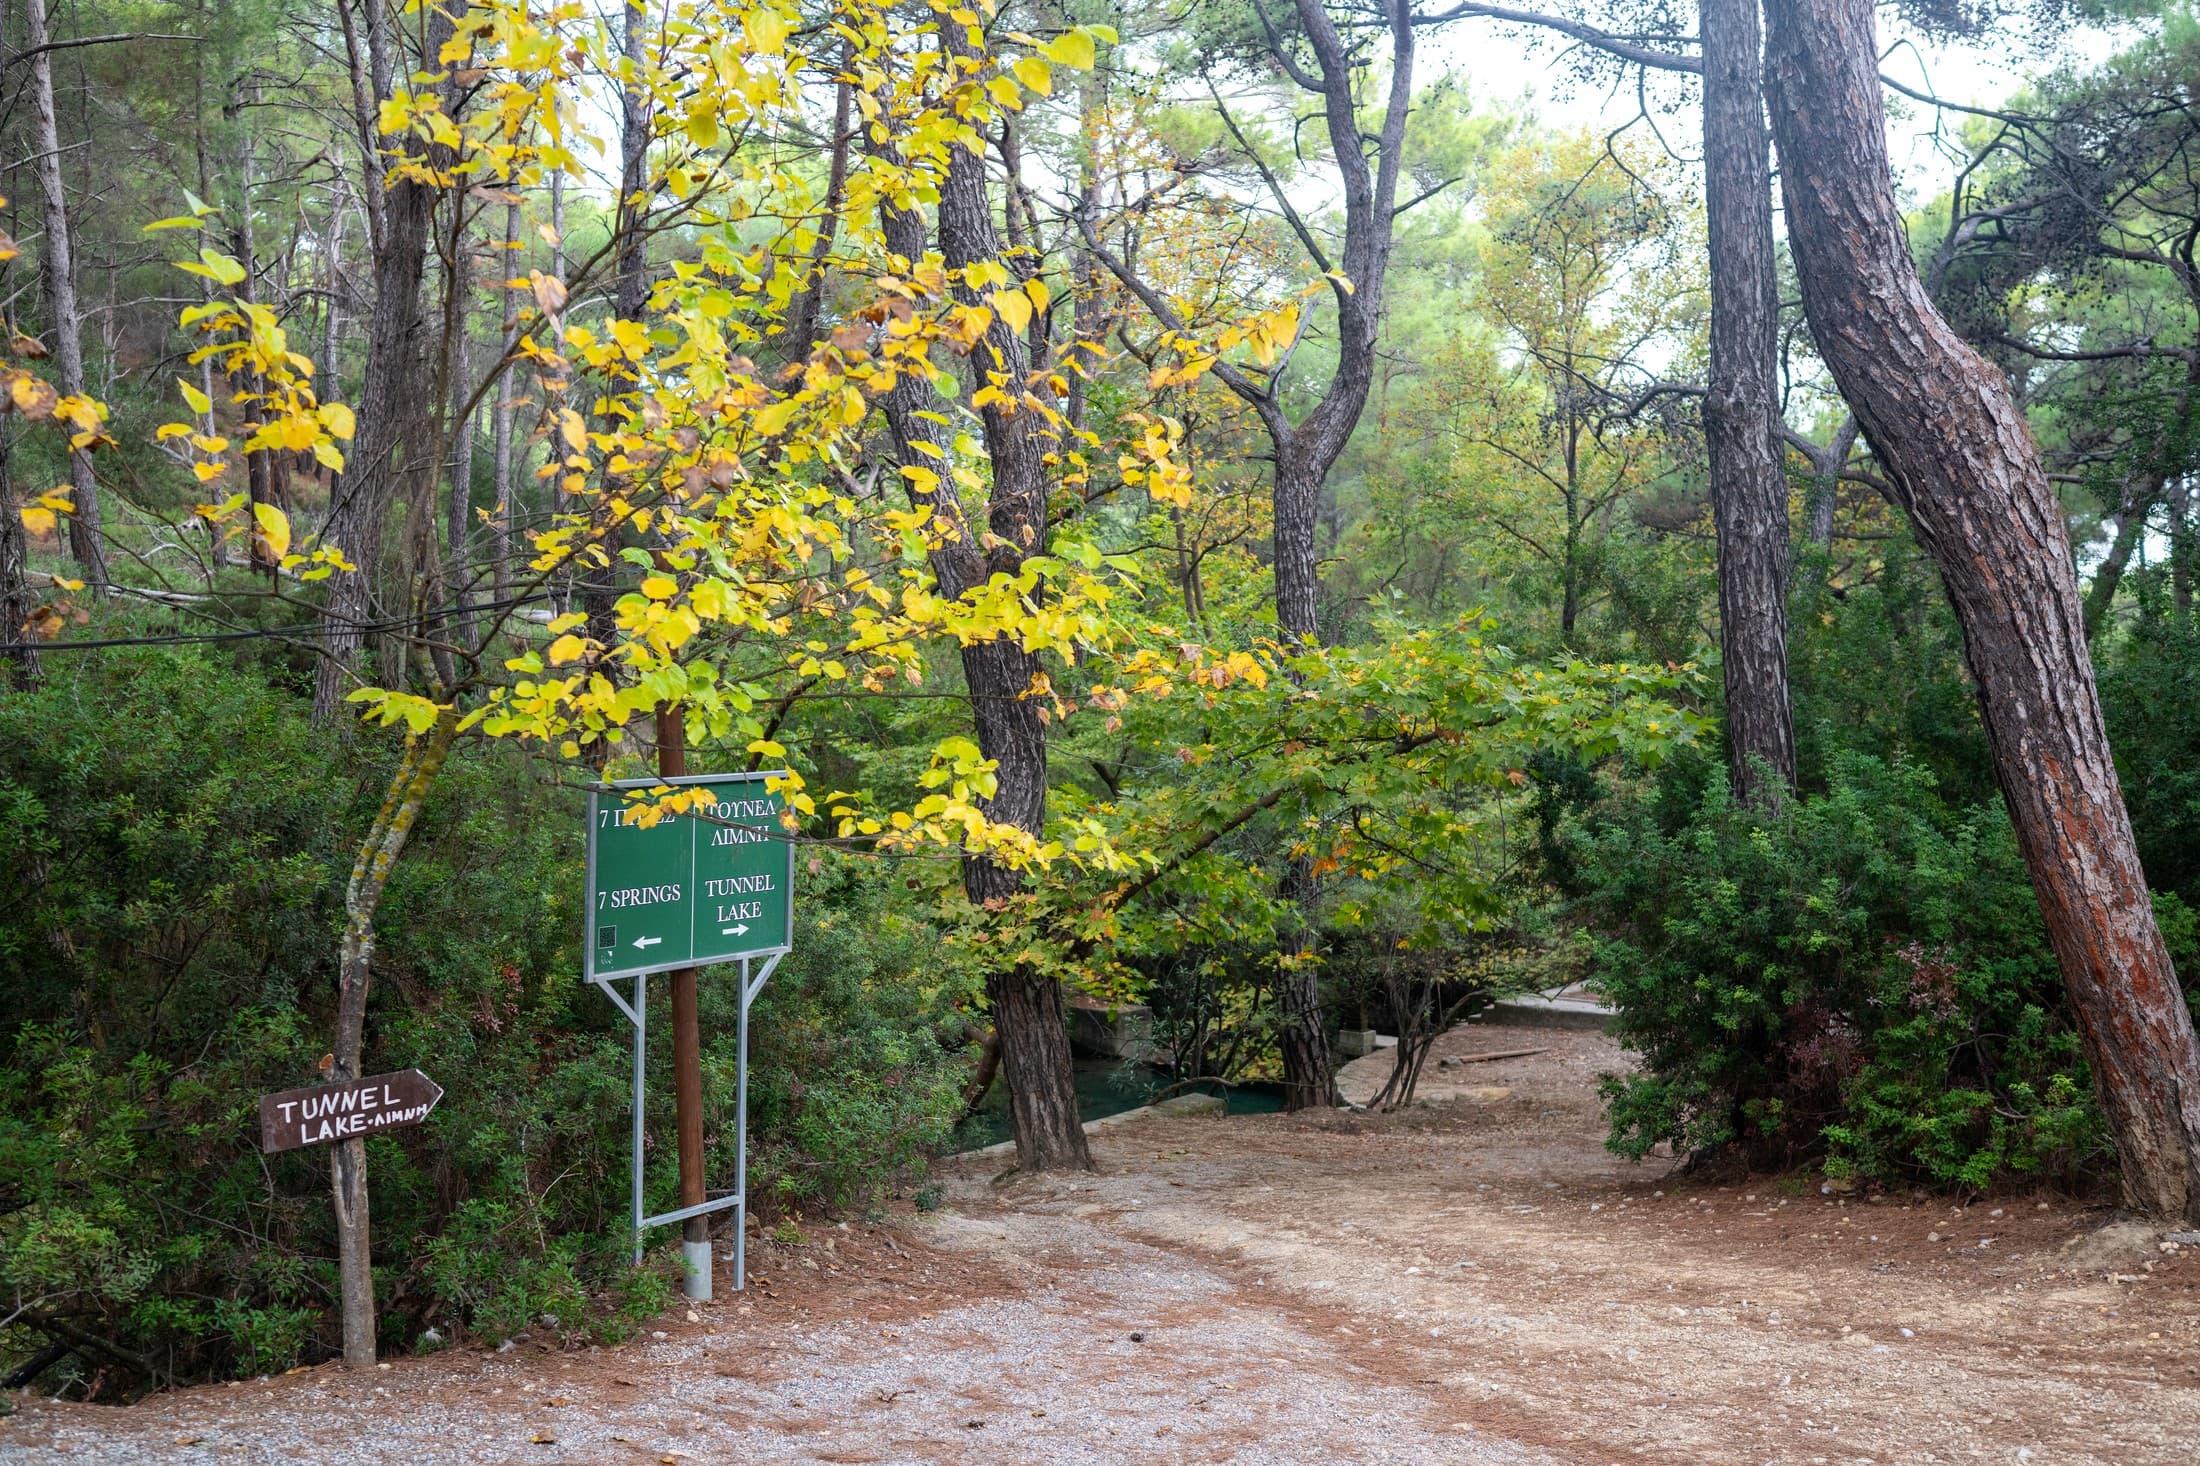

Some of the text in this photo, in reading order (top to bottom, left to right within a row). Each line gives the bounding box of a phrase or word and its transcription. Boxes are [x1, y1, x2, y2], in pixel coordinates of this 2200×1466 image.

[599, 809, 609, 828] 7
[598, 884, 681, 910] 7 SPRINGS
[705, 874, 775, 897] TUNNEL
[717, 901, 762, 923] LAKE
[277, 1084, 401, 1124] TUNNEL
